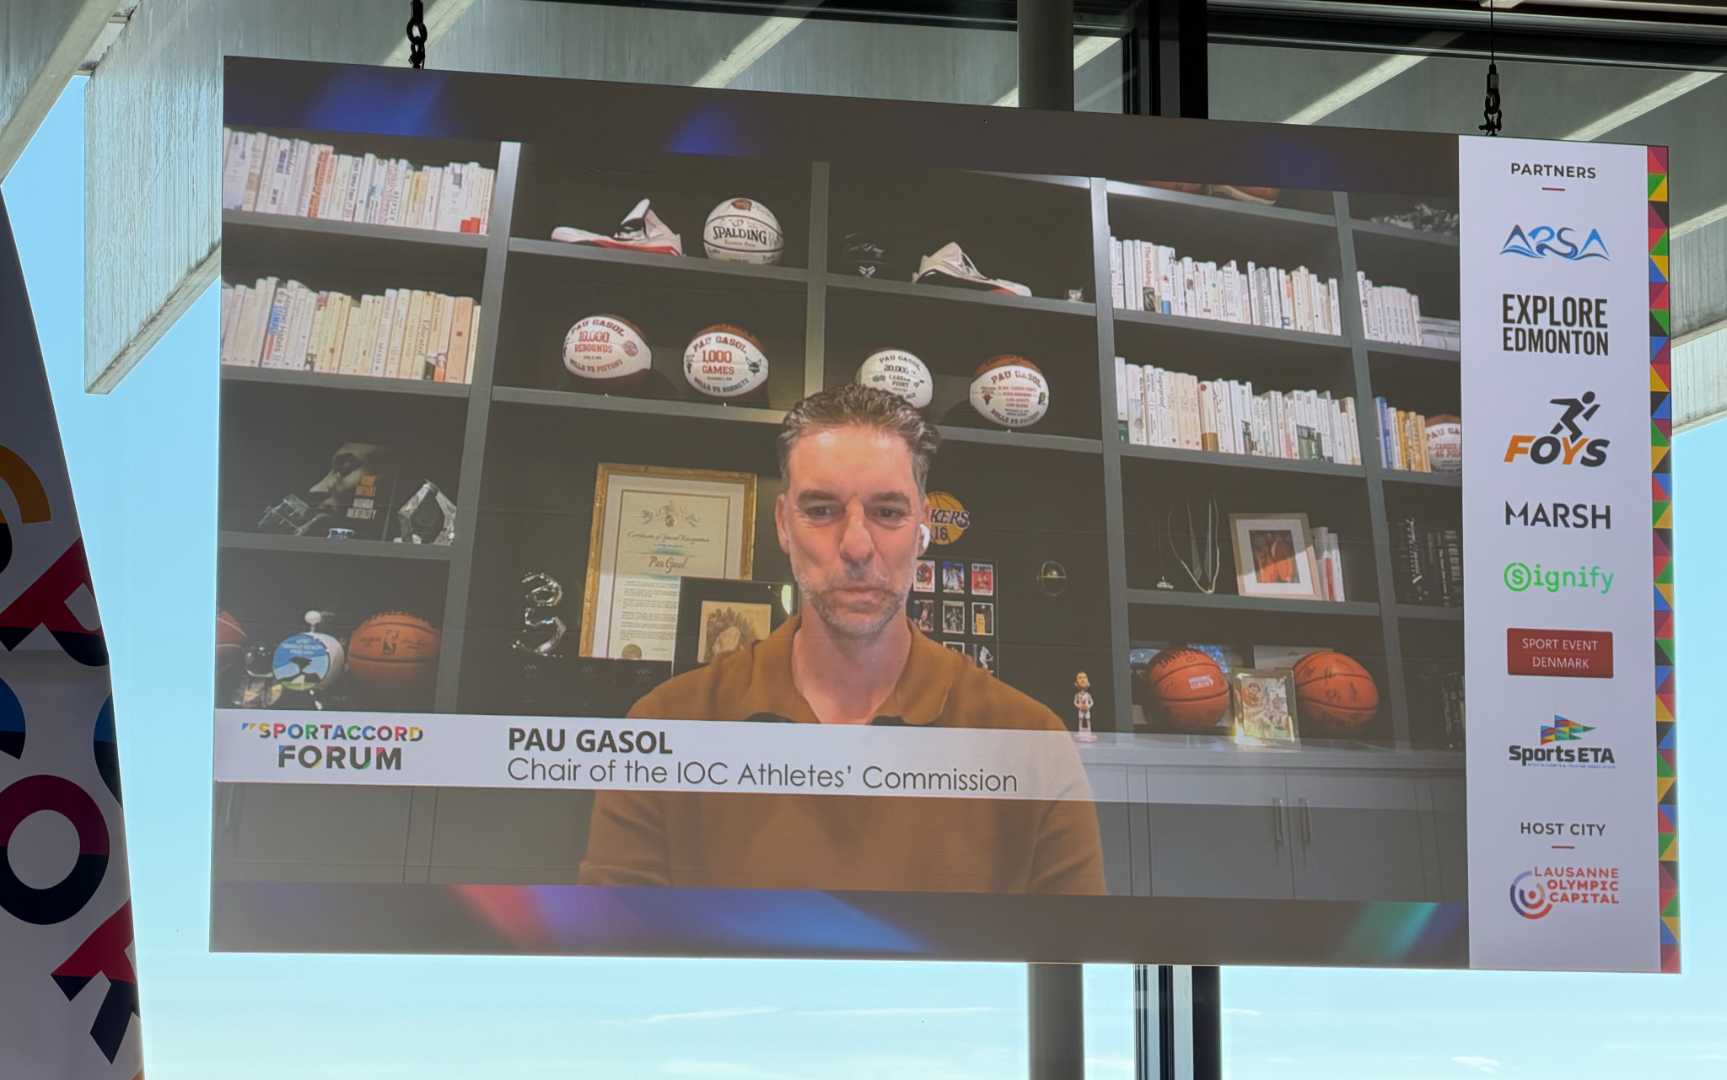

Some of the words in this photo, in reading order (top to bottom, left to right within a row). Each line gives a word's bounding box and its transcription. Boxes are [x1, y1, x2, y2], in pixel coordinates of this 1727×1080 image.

[1511, 163, 1597, 179] PARTNERS
[712, 225, 767, 246] SPALDING
[1502, 294, 1608, 329] EXPLORE
[1503, 327, 1609, 356] EDMONTON
[702, 350, 732, 364] 1,000
[702, 364, 735, 375] GAMES
[991, 370, 1012, 384] PAU
[1503, 435, 1610, 467] FOYS
[929, 508, 970, 529] KERS
[1505, 501, 1611, 530] MARSH
[1522, 637, 1559, 650] SPORT
[1562, 639, 1600, 652] EVENT
[1532, 656, 1590, 670] DENMARK
[258, 722, 424, 743] SPORTACCORD
[508, 727, 566, 752] PAU
[575, 728, 673, 755] GASOL
[277, 745, 403, 771] FORUM
[507, 756, 581, 782] Chair
[590, 758, 617, 783] of
[624, 760, 667, 784] the
[677, 761, 728, 785] IOC
[738, 763, 852, 788] Athletes'
[862, 765, 1018, 792] Commission
[1520, 822, 1564, 836] HOST
[1570, 823, 1606, 837] CITY
[1534, 866, 1619, 879] LAUSANNE
[1547, 879, 1619, 892] OLYMPIC
[1549, 892, 1619, 905] CAPITAL
